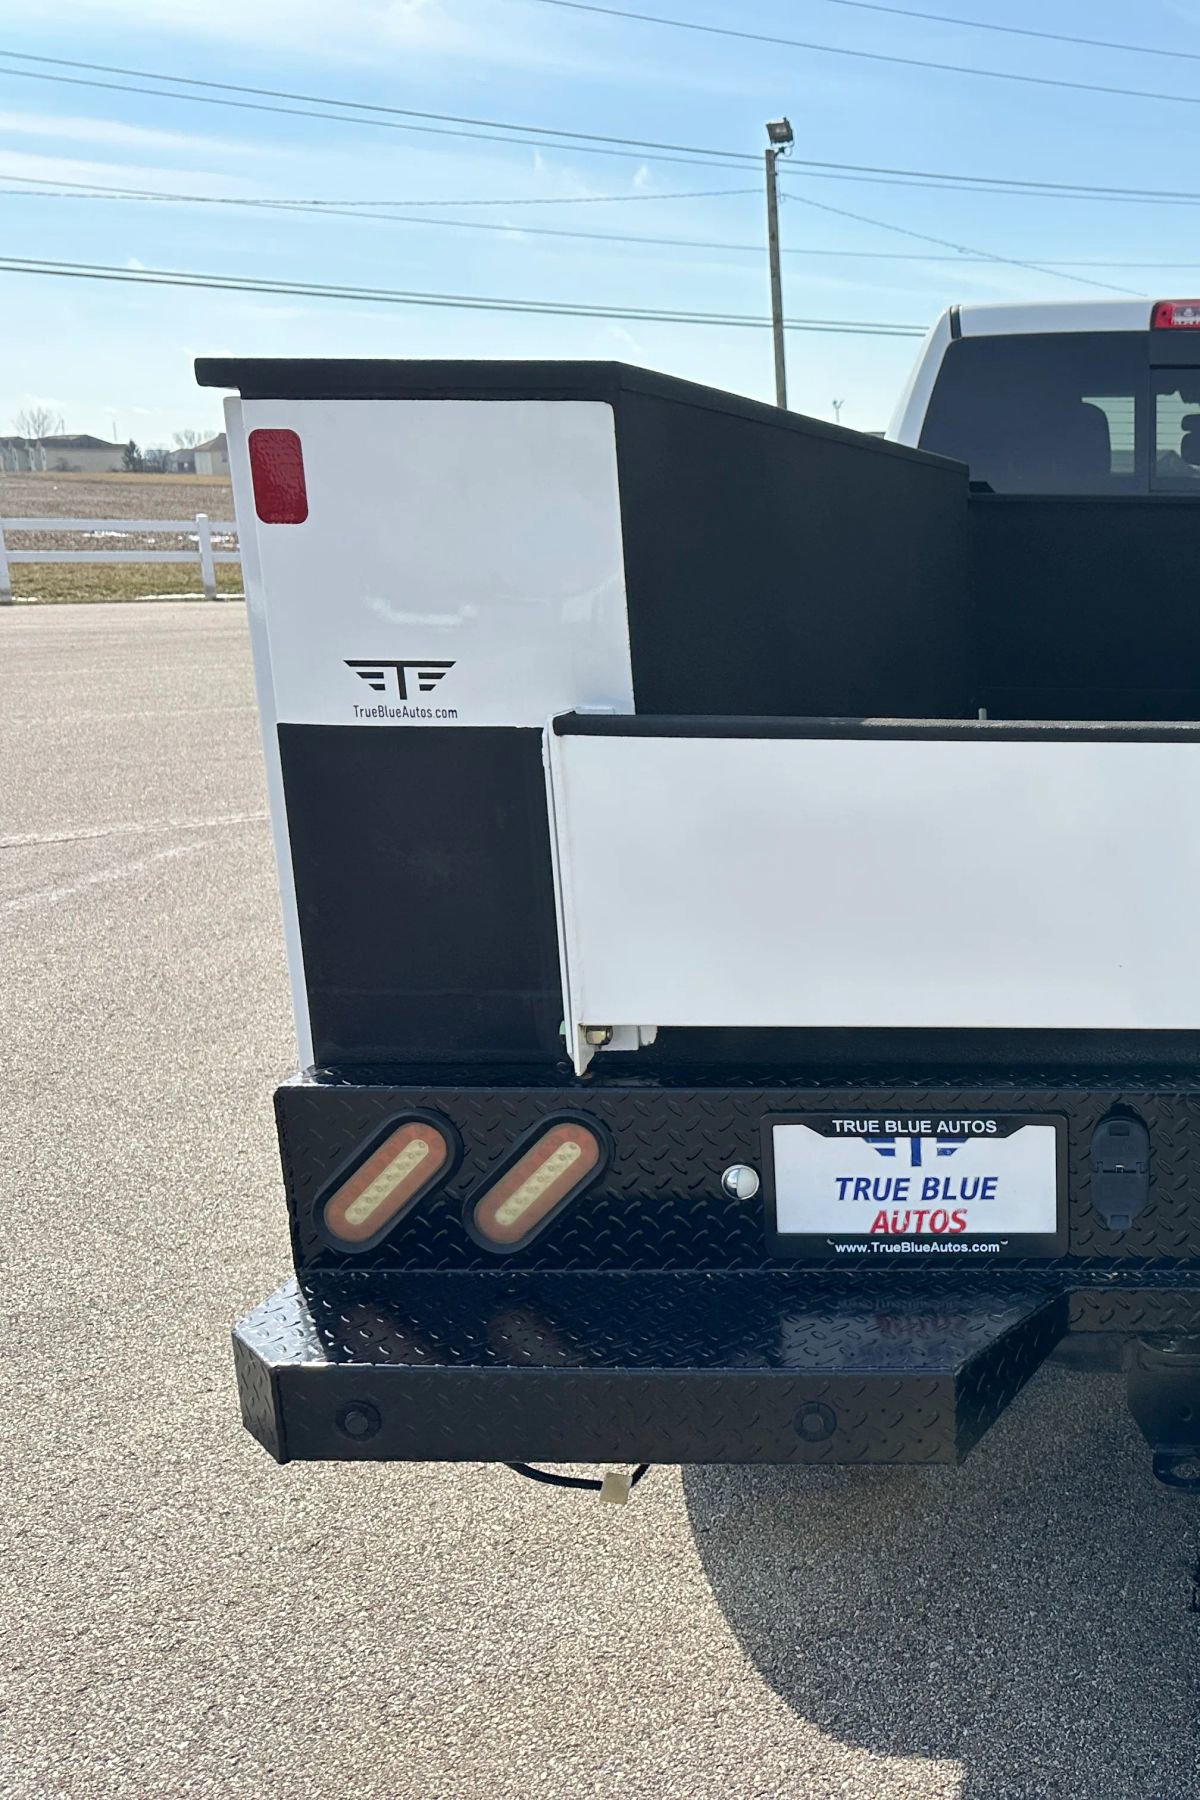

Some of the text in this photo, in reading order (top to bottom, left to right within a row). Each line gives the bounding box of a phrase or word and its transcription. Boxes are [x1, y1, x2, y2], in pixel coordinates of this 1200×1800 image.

[353, 705, 458, 719] TrueBlueAutos.com
[832, 1119, 997, 1133] TRUE BLUE AUTOS
[835, 1176, 999, 1201] TRUE BLUE
[869, 1208, 968, 1234] AUTOS
[834, 1241, 1000, 1253] www.TrueBlueAutos.com
